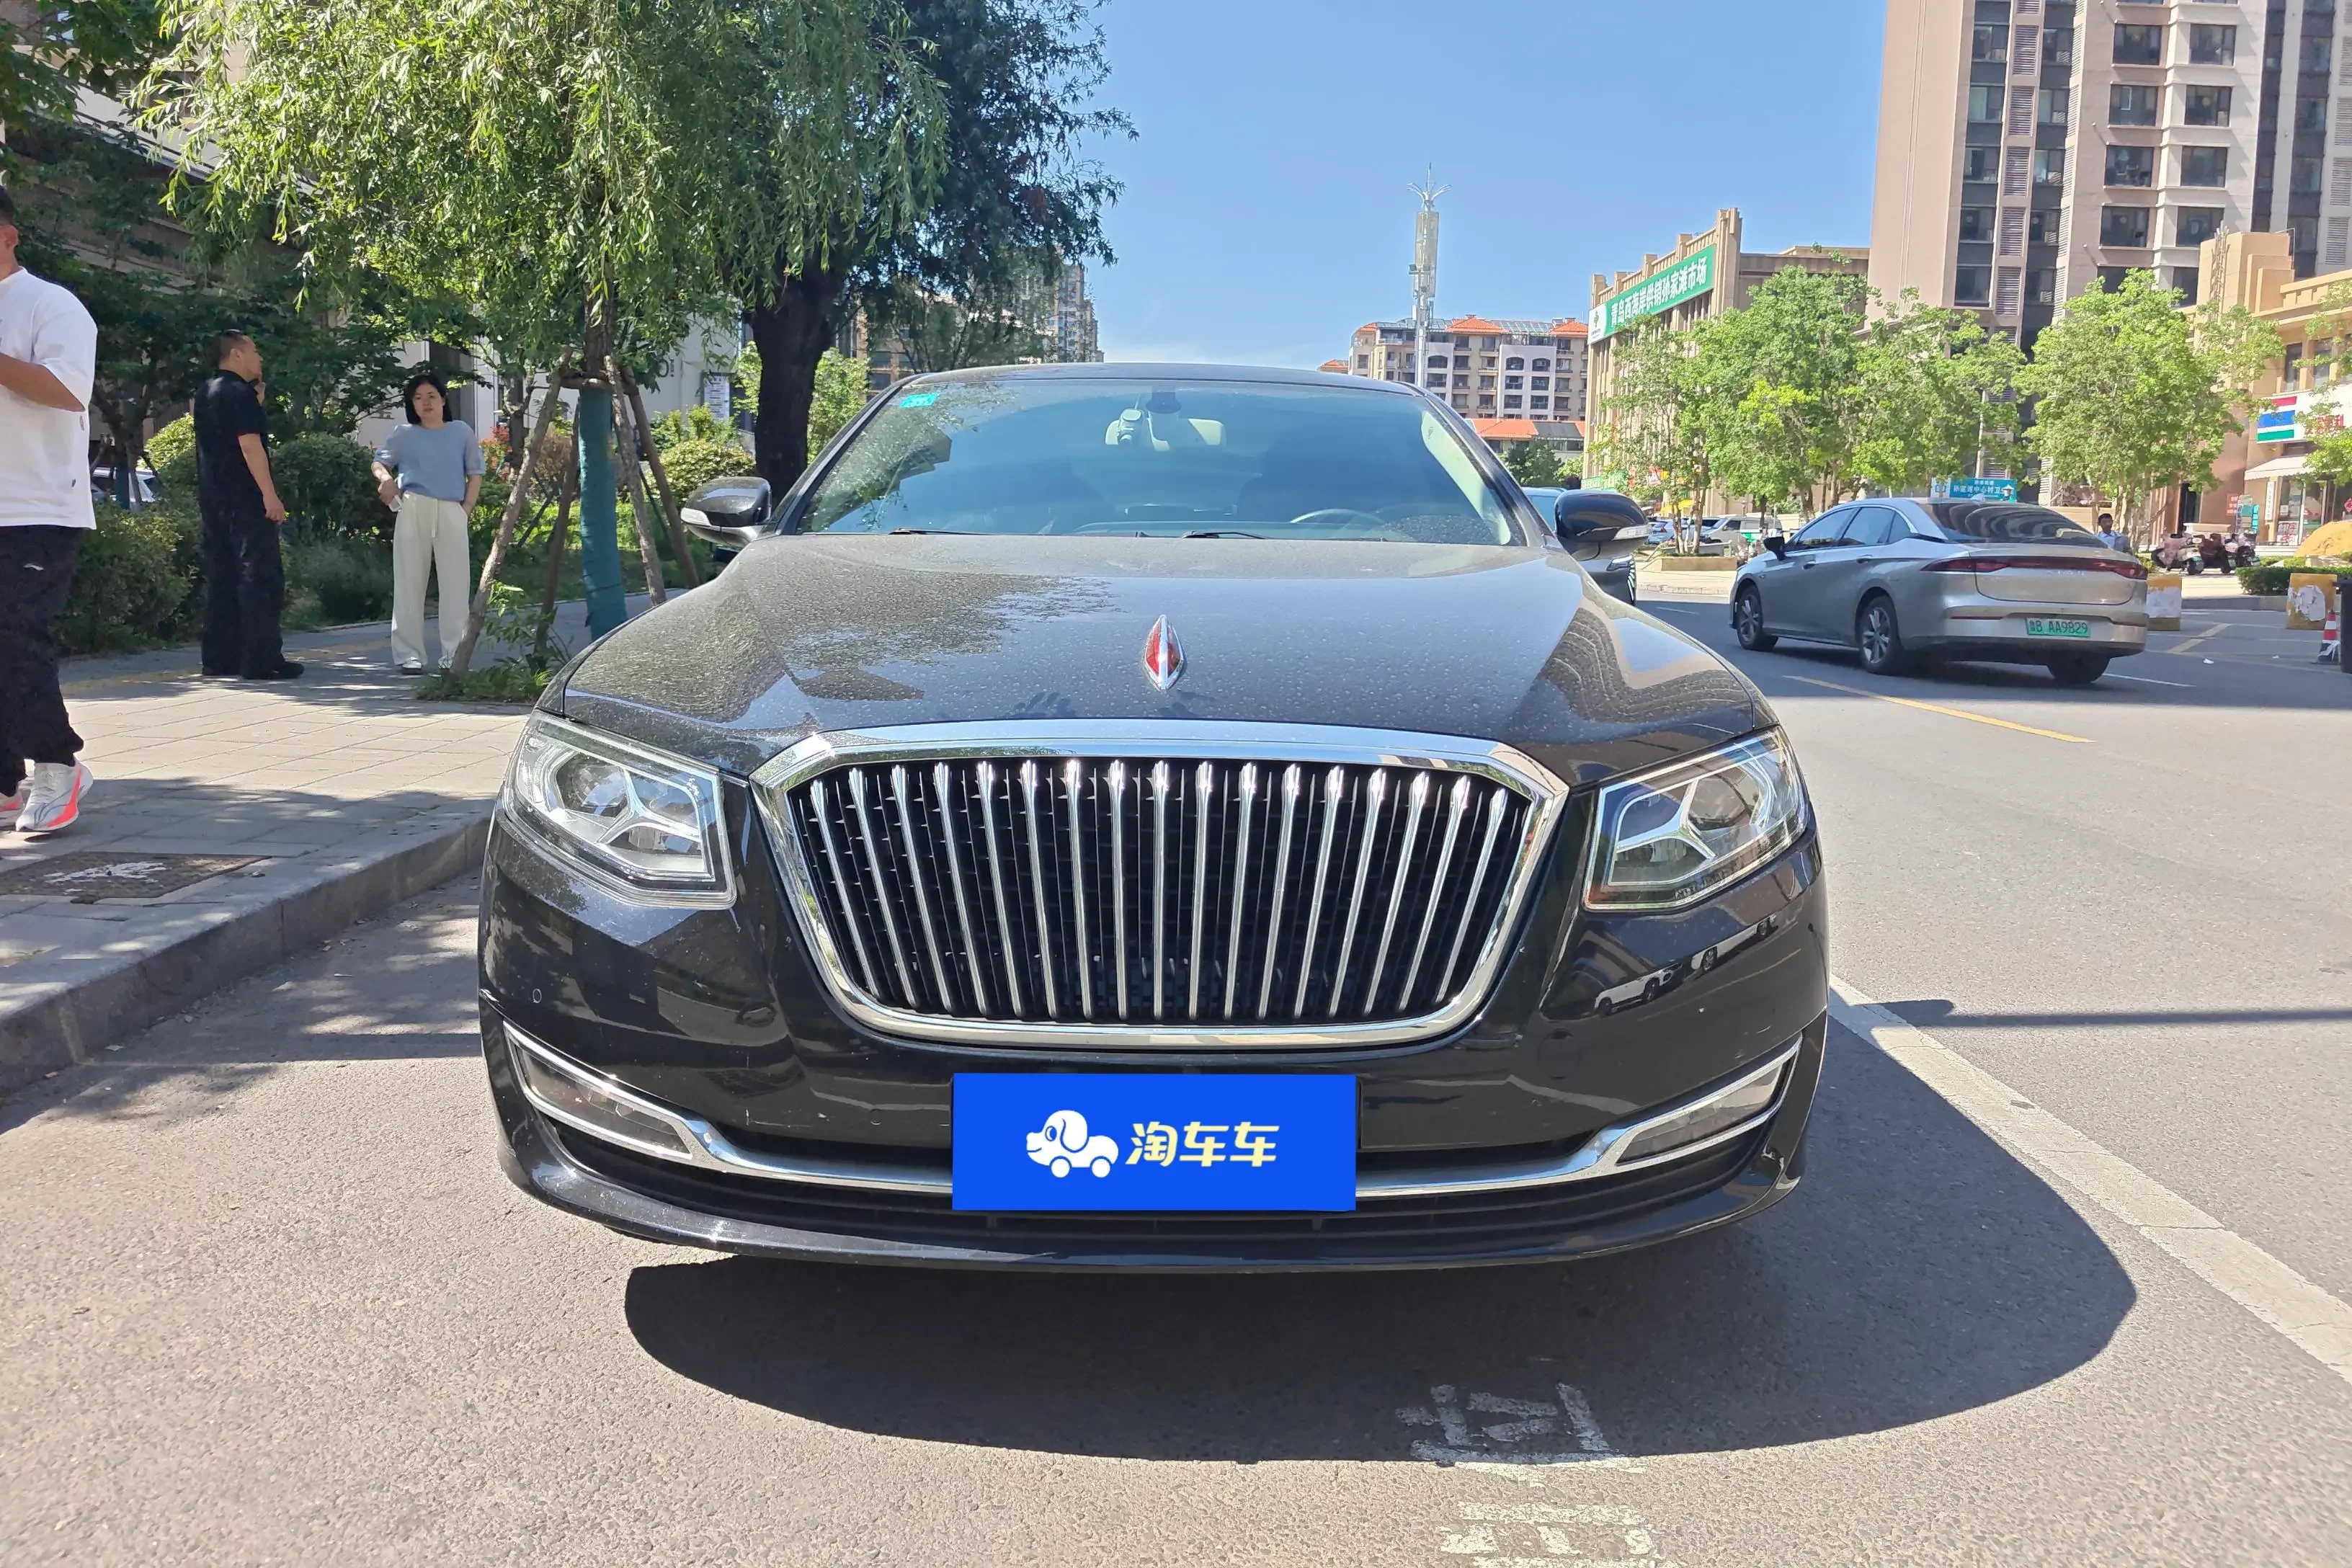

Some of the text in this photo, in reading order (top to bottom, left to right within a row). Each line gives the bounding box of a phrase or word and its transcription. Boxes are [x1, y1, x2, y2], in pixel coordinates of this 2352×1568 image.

[1611, 256, 1707, 328] 青岛西海岸供销孙家滩市场
[1954, 485, 2014, 494] 孙家滩中心村卫
